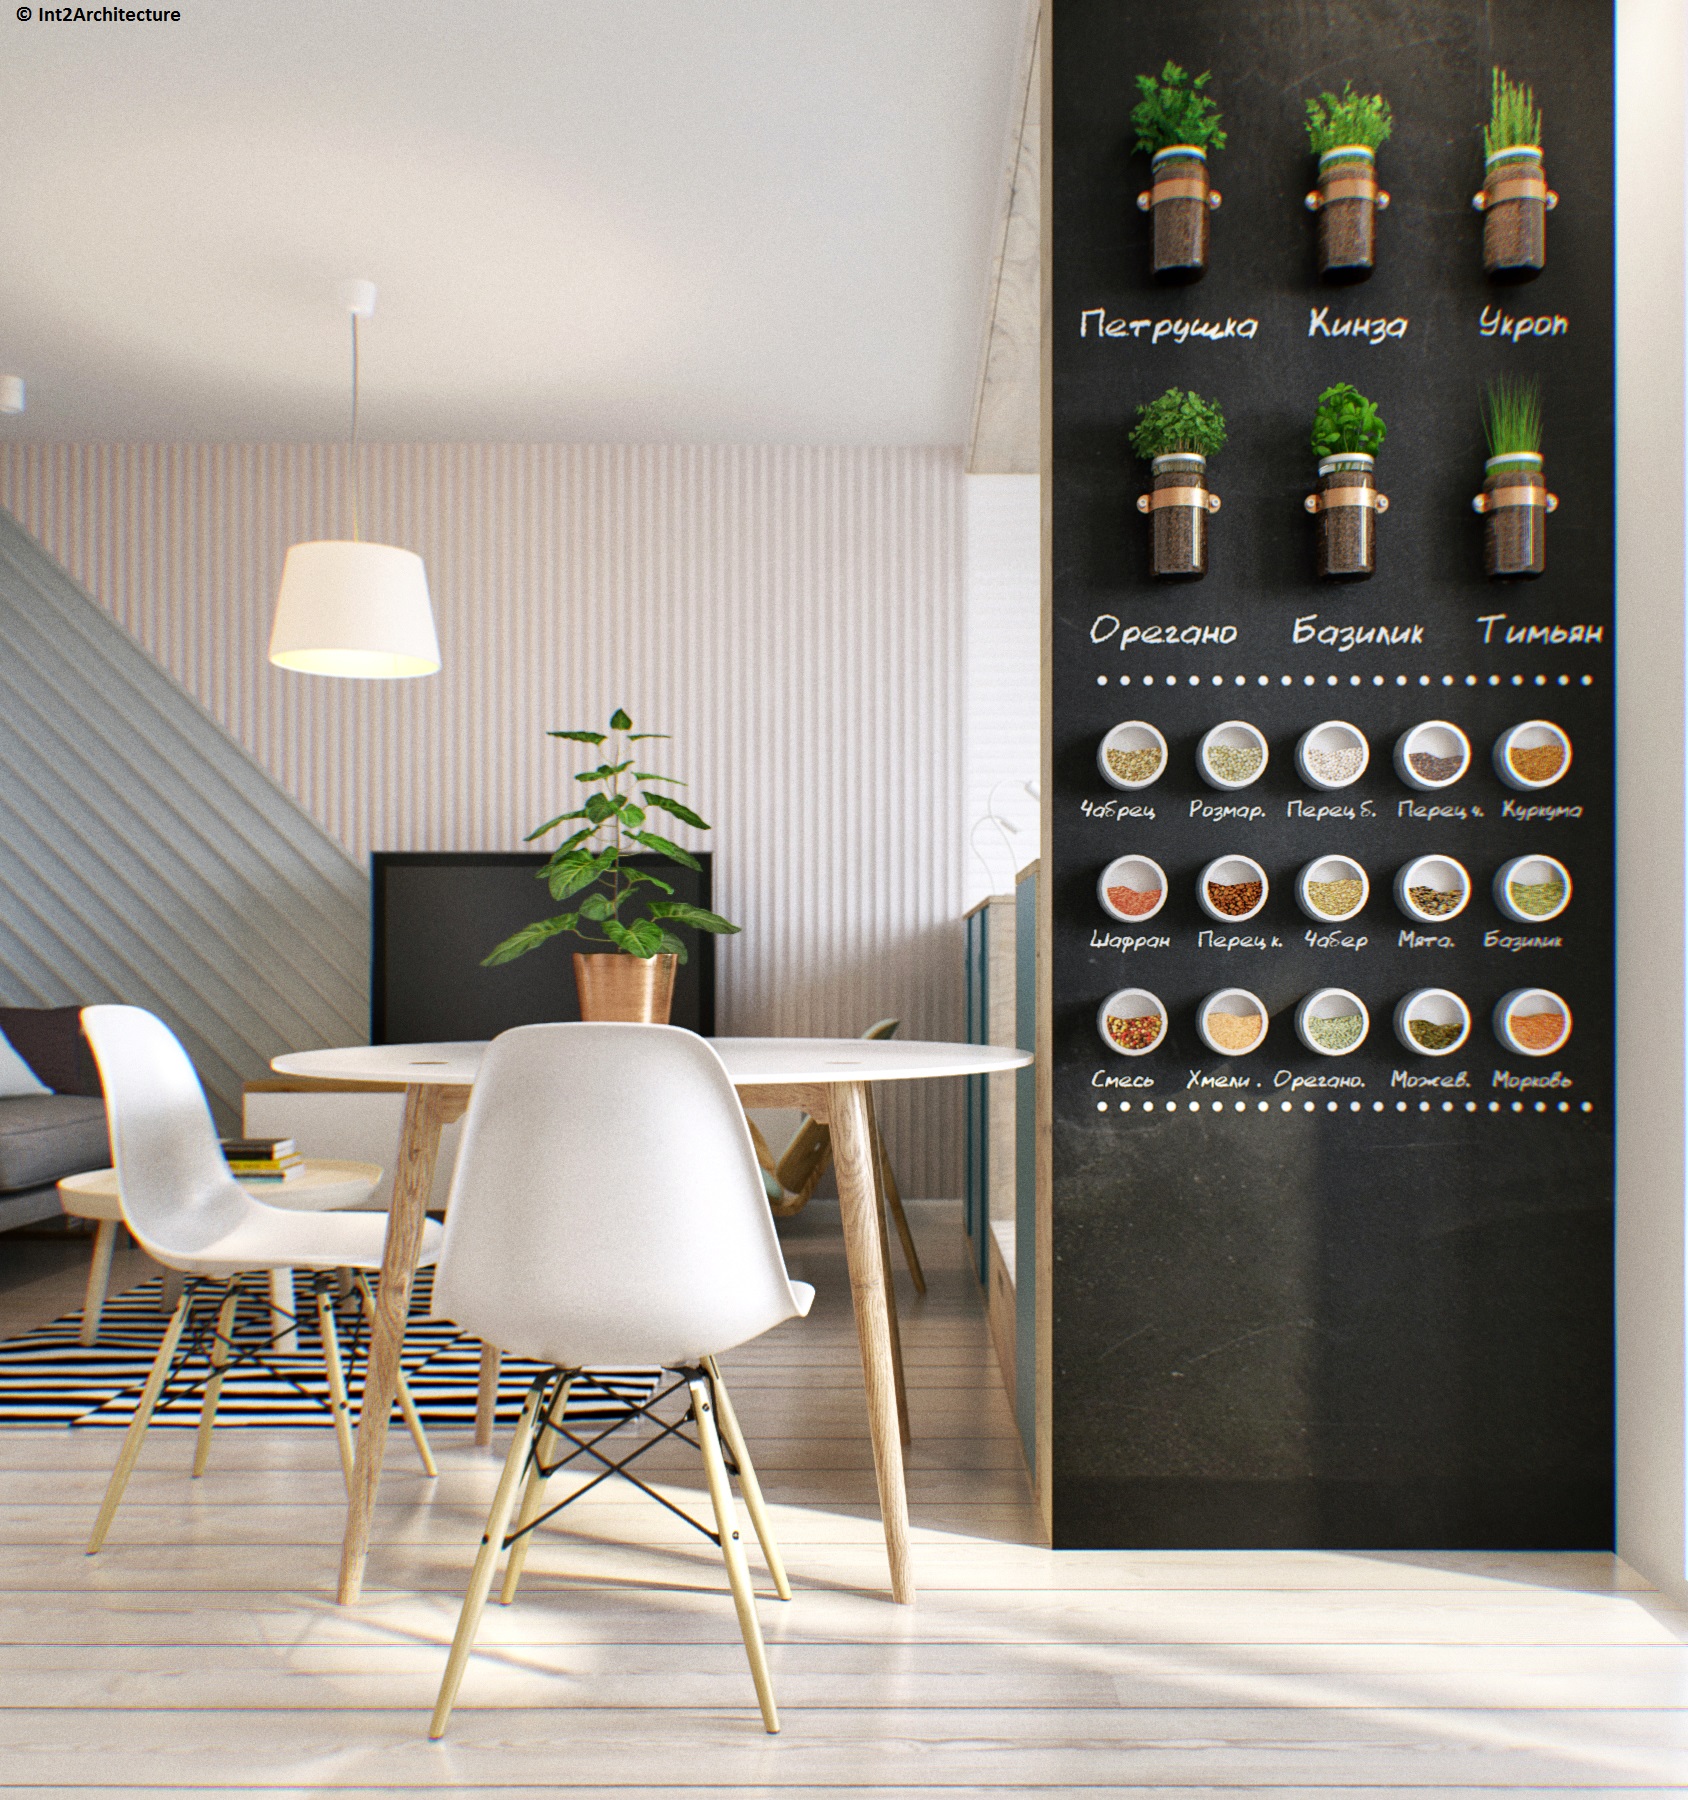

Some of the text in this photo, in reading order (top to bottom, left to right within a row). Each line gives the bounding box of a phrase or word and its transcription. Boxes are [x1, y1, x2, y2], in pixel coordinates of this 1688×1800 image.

[1080, 307, 1259, 345] Петрушка
[1308, 306, 1409, 345] Кинза
[1479, 305, 1568, 343] Укроп
[1089, 613, 1238, 651] Орегано
[1292, 613, 1424, 653] Базилик
[1477, 613, 1604, 644] Тимьян
[1080, 799, 1156, 822] Чабрец
[1189, 799, 1266, 822] Розмар.
[1286, 799, 1355, 822] Перец
[1397, 799, 1468, 822] Перец
[1501, 799, 1583, 821] Куркума
[1089, 928, 1171, 954] Шафран
[1197, 930, 1266, 951] Перец
[1304, 929, 1369, 952] Чабер
[1397, 929, 1456, 949] Мята.
[1482, 929, 1563, 953] Базилик
[1091, 1069, 1155, 1089] Смесь
[1273, 1069, 1366, 1092] Орегано.
[1390, 1069, 1472, 1089] Можев.
[1491, 1069, 1574, 1092] Морковь
